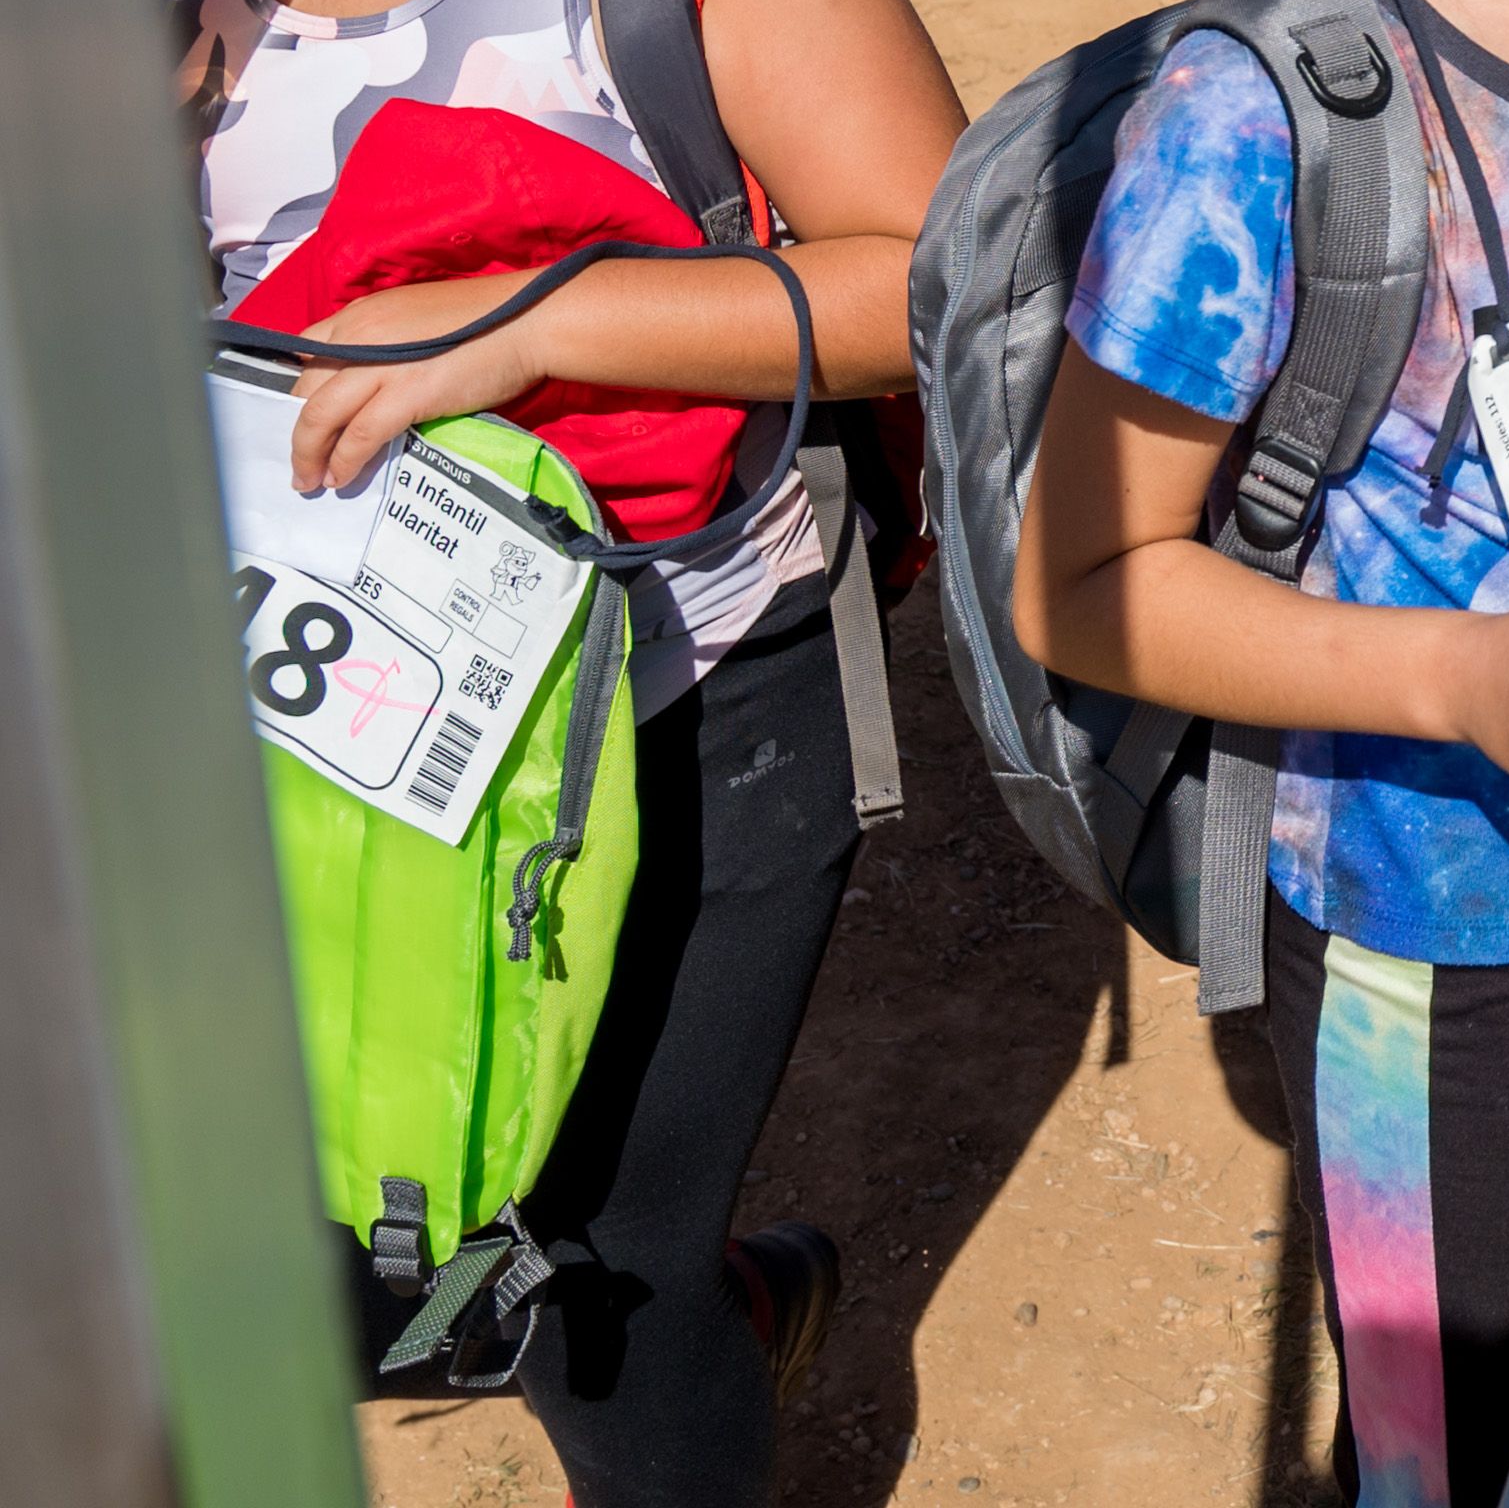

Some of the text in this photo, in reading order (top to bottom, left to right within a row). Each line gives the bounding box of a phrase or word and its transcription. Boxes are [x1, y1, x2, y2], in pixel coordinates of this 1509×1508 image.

[1484, 394, 1500, 417] 112
[407, 437, 472, 484] STIFIQUIS
[415, 476, 488, 536] Infantil
[449, 600, 475, 622] REGALS
[453, 587, 482, 612] CONTROL
